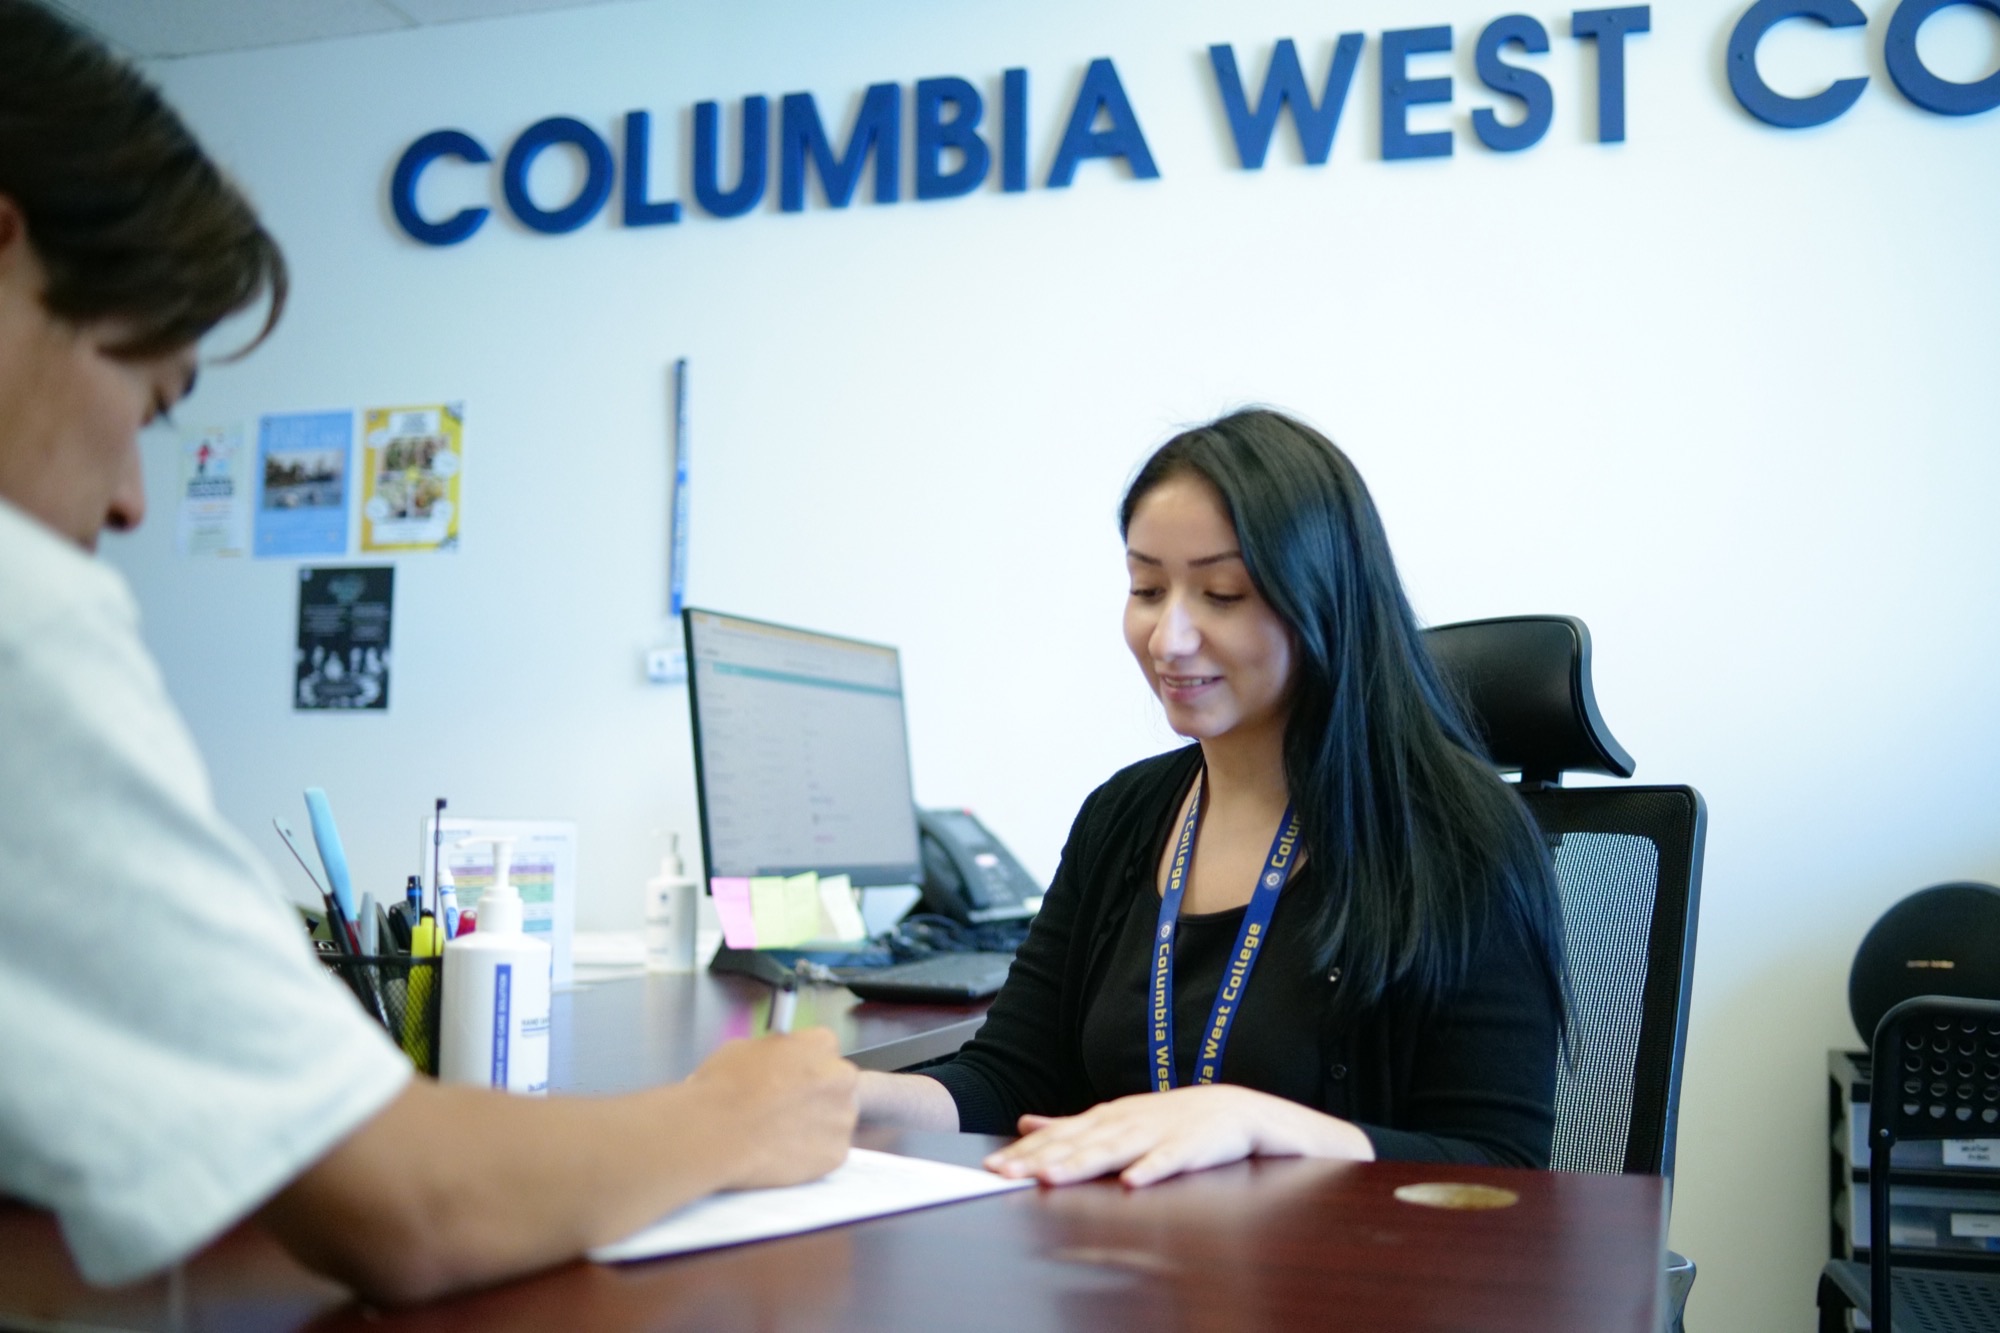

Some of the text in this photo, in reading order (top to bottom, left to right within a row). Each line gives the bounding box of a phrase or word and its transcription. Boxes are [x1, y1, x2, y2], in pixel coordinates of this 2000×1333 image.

[391, 0, 2000, 247] COLUMBIA WEST CO
[1171, 820, 1195, 890] College
[1154, 943, 1170, 1042] Columbia
[1203, 1006, 1231, 1059] West
[1222, 922, 1262, 1001] College
